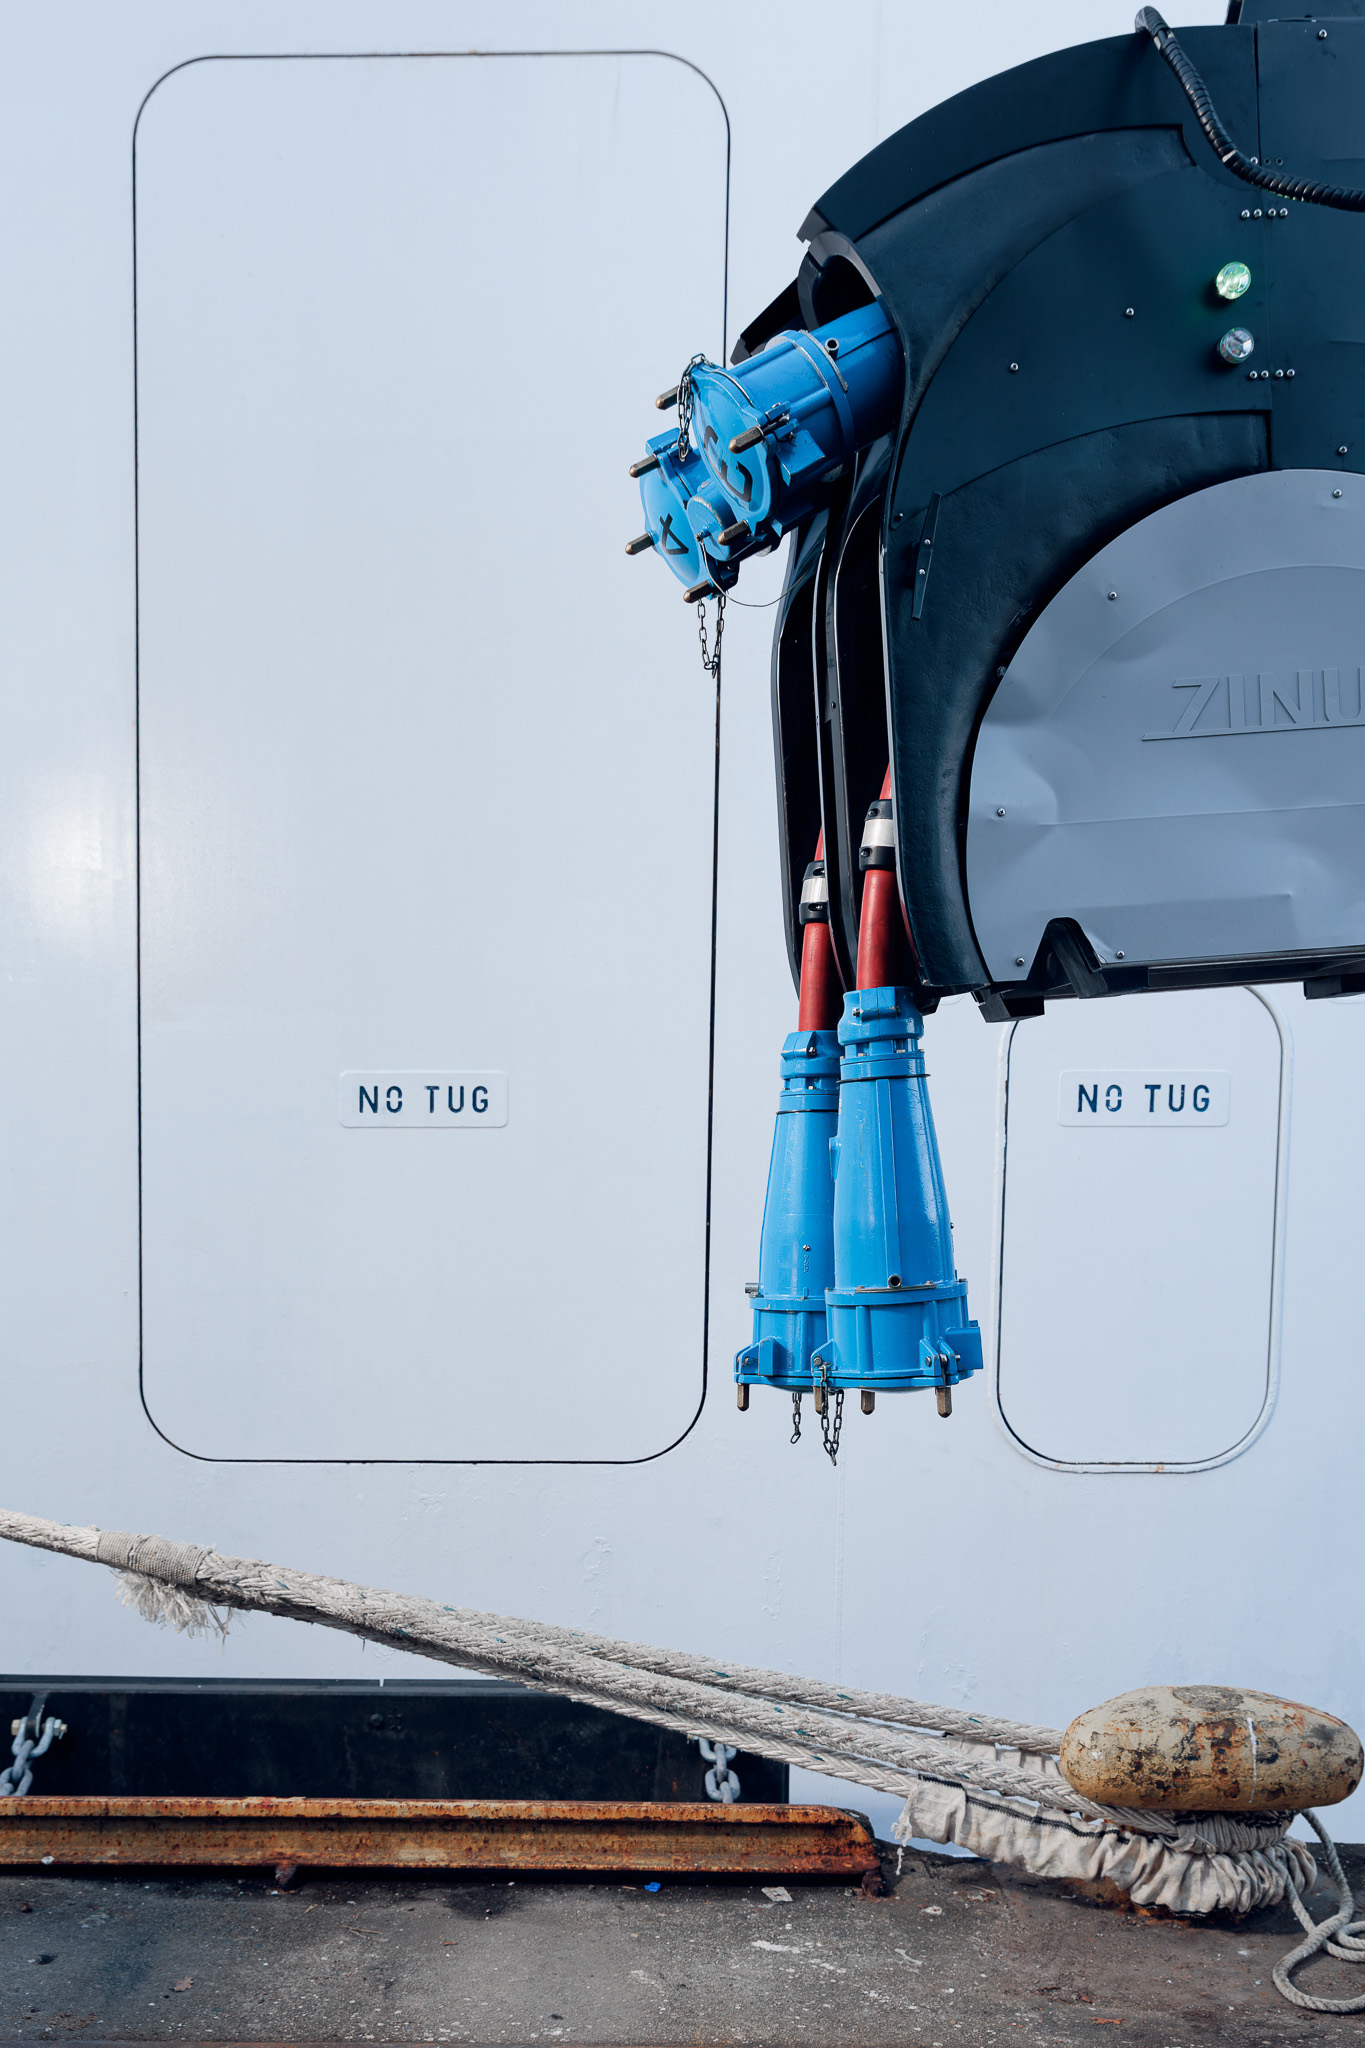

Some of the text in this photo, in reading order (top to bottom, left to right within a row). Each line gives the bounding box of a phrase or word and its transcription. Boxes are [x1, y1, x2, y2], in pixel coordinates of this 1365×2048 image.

[359, 1085, 489, 1114] NO TUG
[1077, 1084, 1210, 1113] NO TUG
